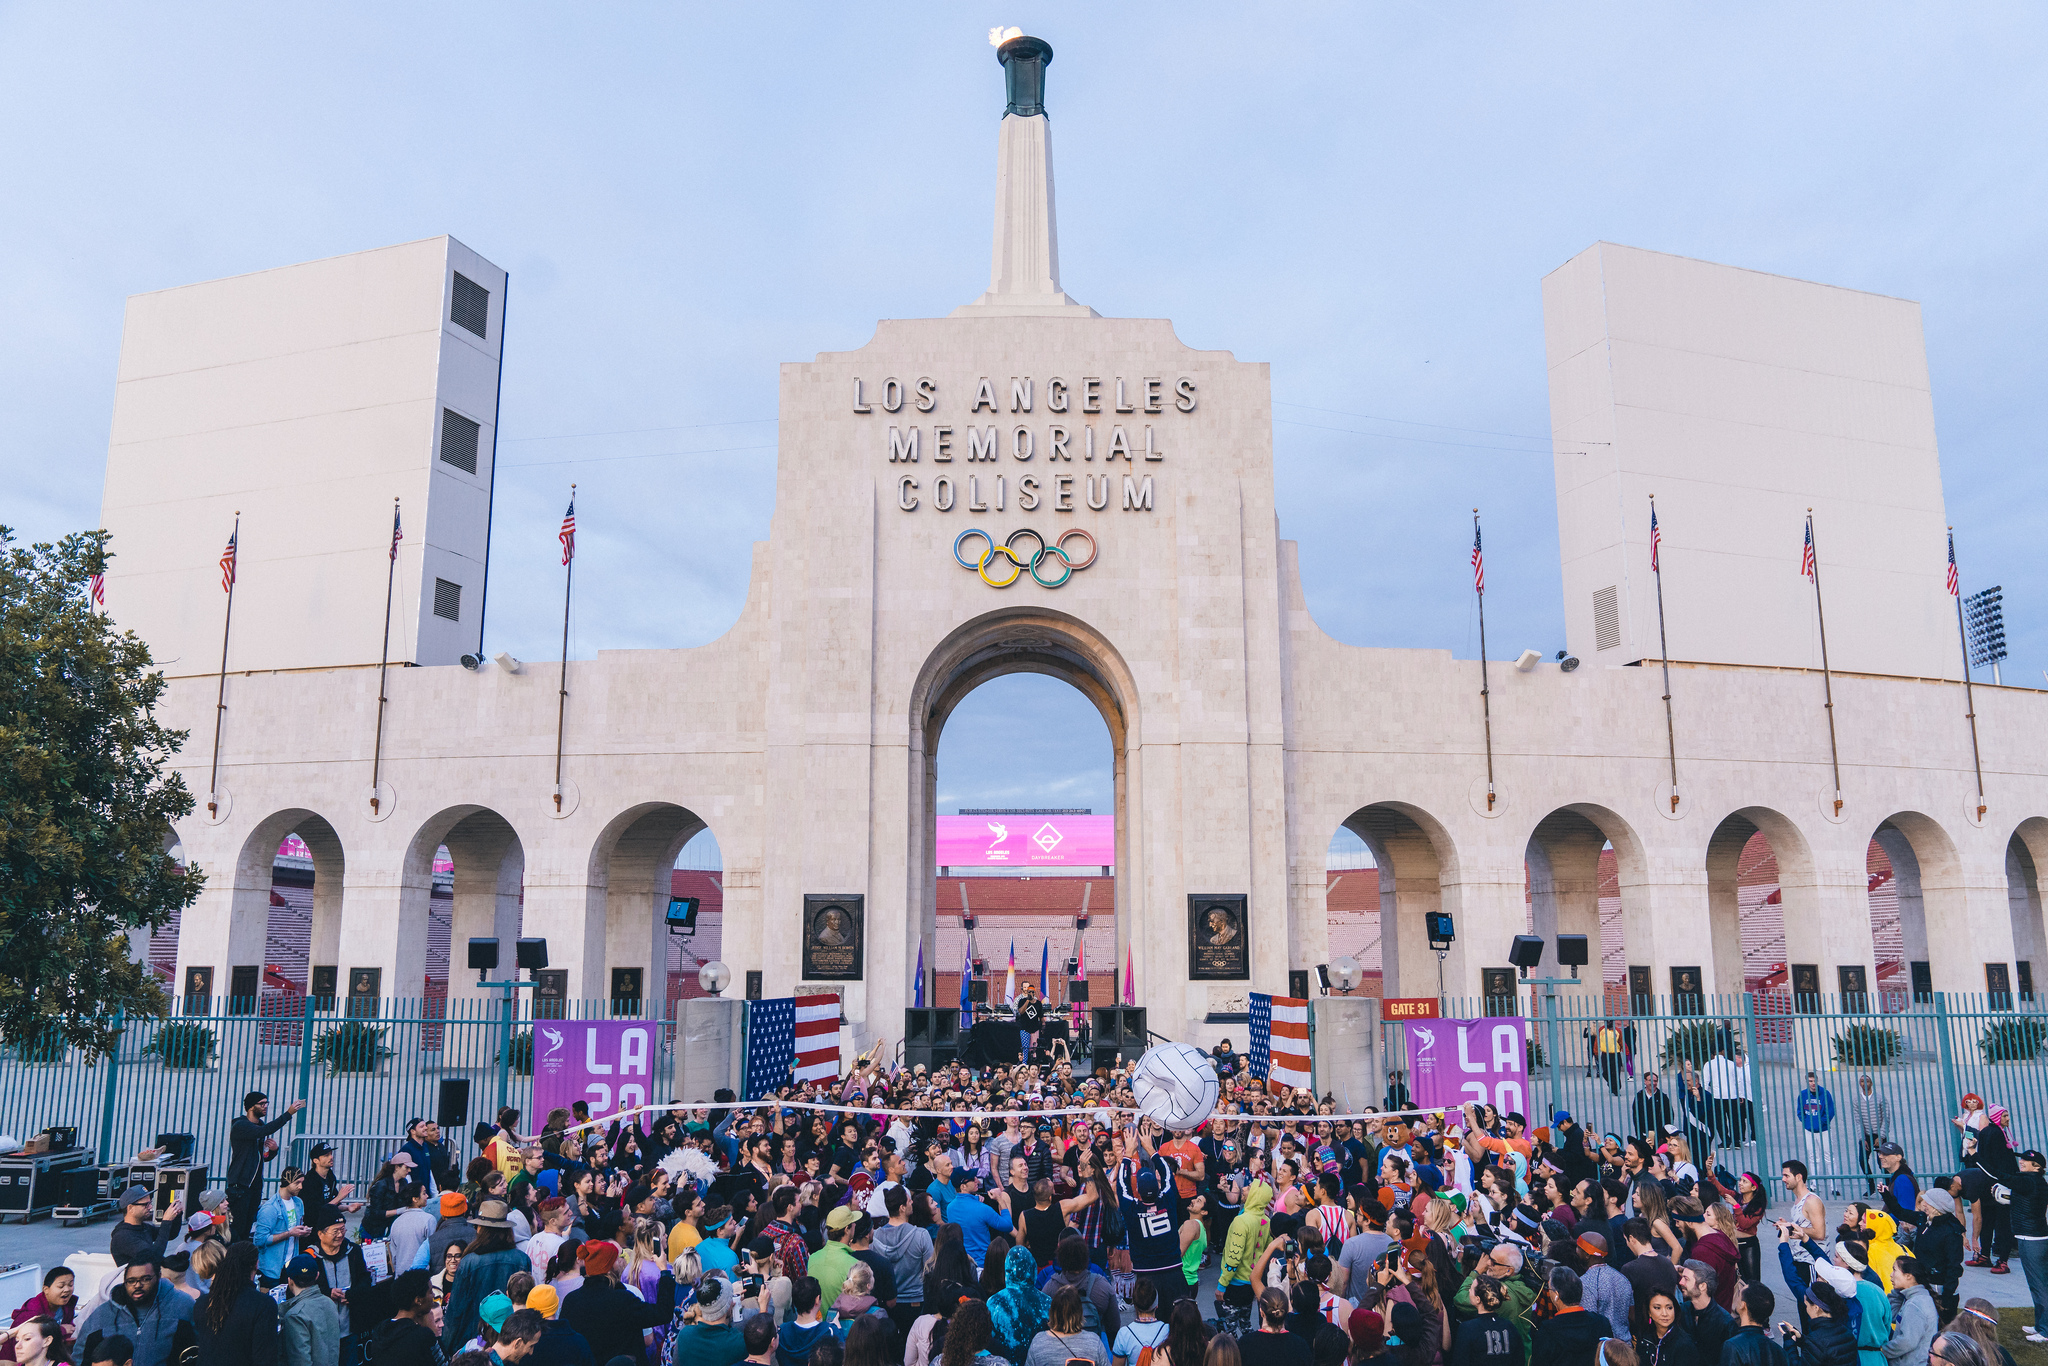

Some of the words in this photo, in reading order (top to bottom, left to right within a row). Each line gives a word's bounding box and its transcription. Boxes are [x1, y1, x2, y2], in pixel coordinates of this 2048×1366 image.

[853, 376, 937, 414] LOS
[971, 376, 1198, 414] ANGELES
[888, 424, 1164, 463] MEMORIAL
[897, 473, 1153, 512] COLISEUM
[1390, 1003, 1415, 1015] GATE
[1417, 1003, 1430, 1015] 31
[586, 1027, 649, 1076] LA
[1457, 1024, 1521, 1073] LA
[1140, 1212, 1171, 1238] 16
[1484, 1329, 1510, 1355] 13.1
